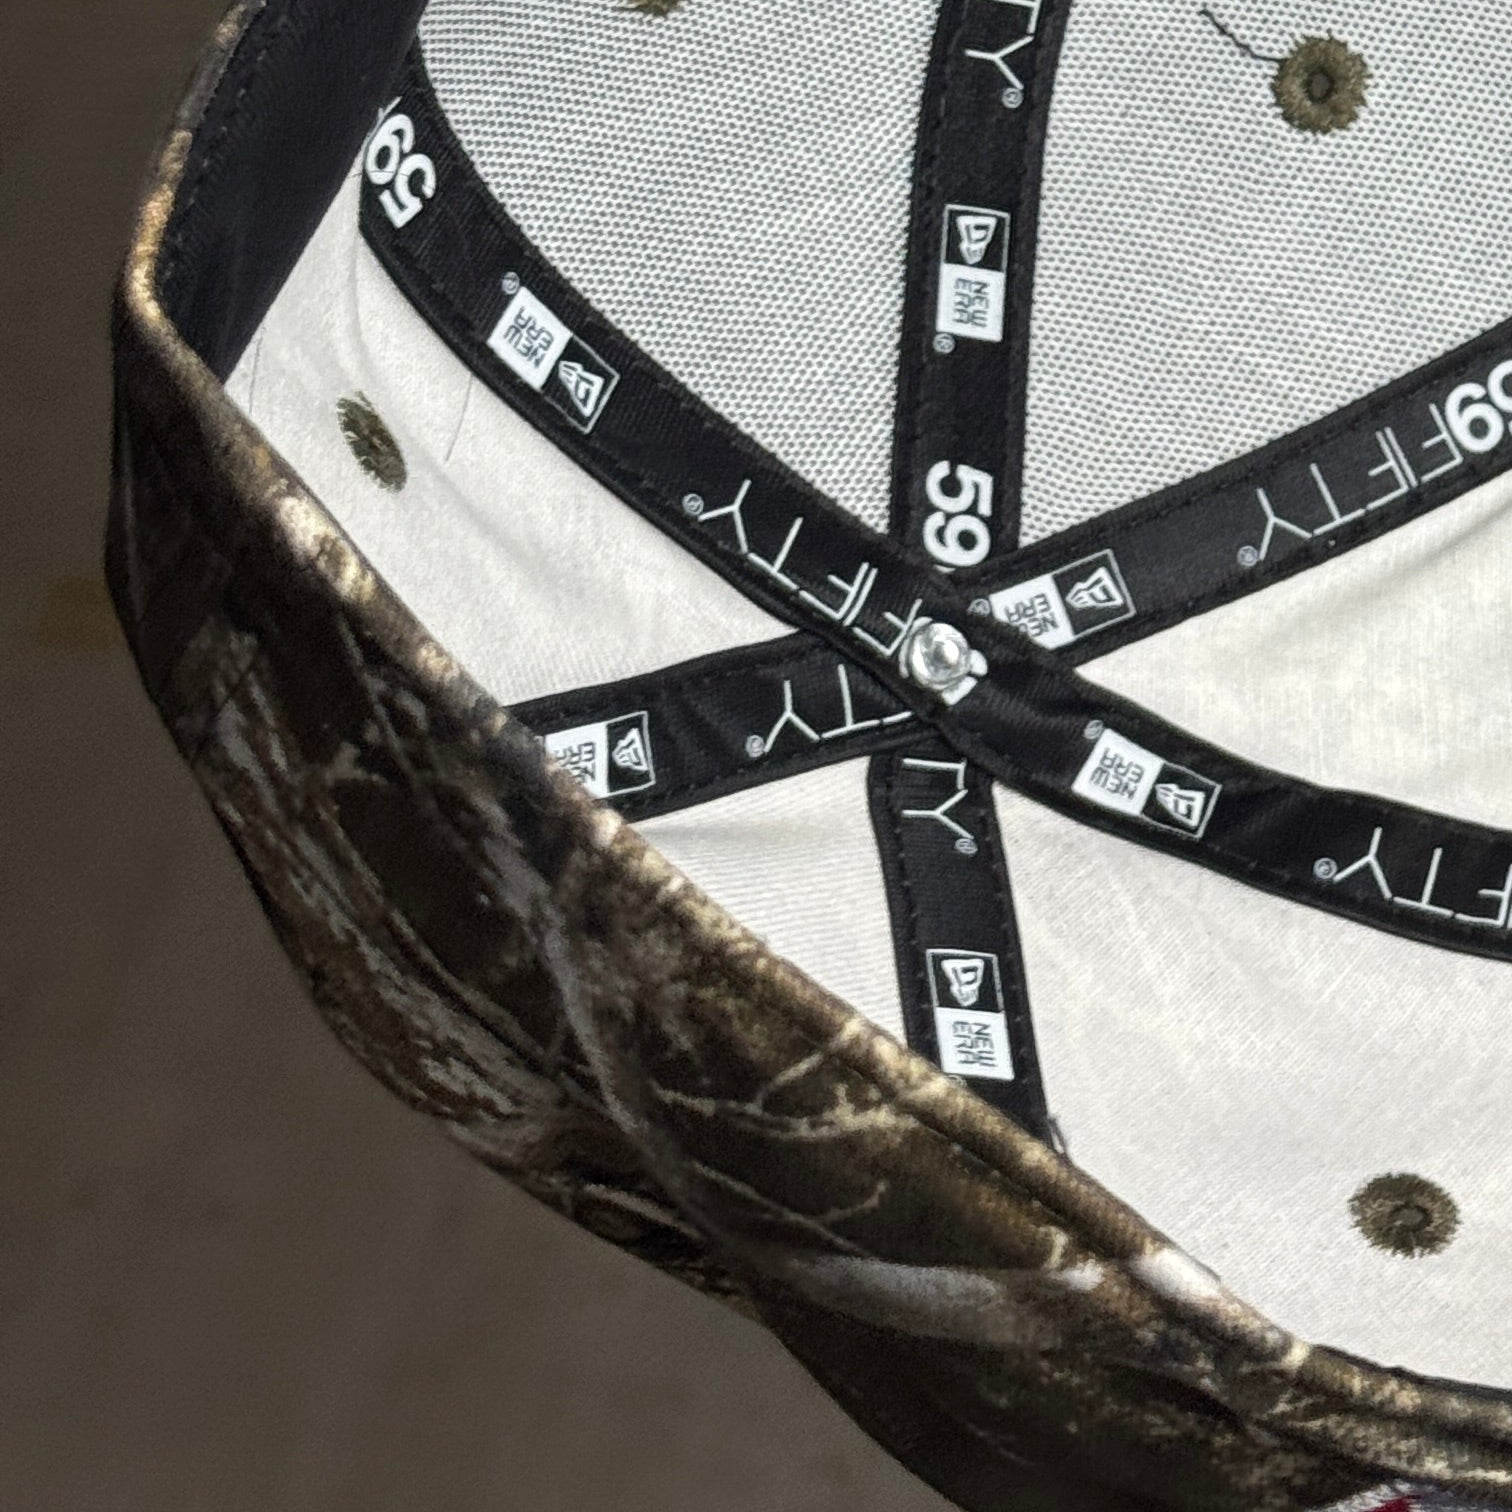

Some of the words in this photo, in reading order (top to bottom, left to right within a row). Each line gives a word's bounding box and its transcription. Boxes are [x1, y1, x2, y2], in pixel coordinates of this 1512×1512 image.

[365, 98, 437, 229] 59
[951, 277, 972, 325] ERA
[969, 280, 990, 329] NEW
[502, 323, 546, 369] NEW
[513, 305, 555, 352] ERA
[922, 459, 994, 572] 59
[698, 478, 988, 706] FIFTY
[1004, 592, 1051, 624] ERA
[1088, 766, 1138, 801] NEW
[1099, 746, 1146, 784] ERA
[951, 1020, 980, 1065] ERA
[971, 1022, 998, 1068] NEW
